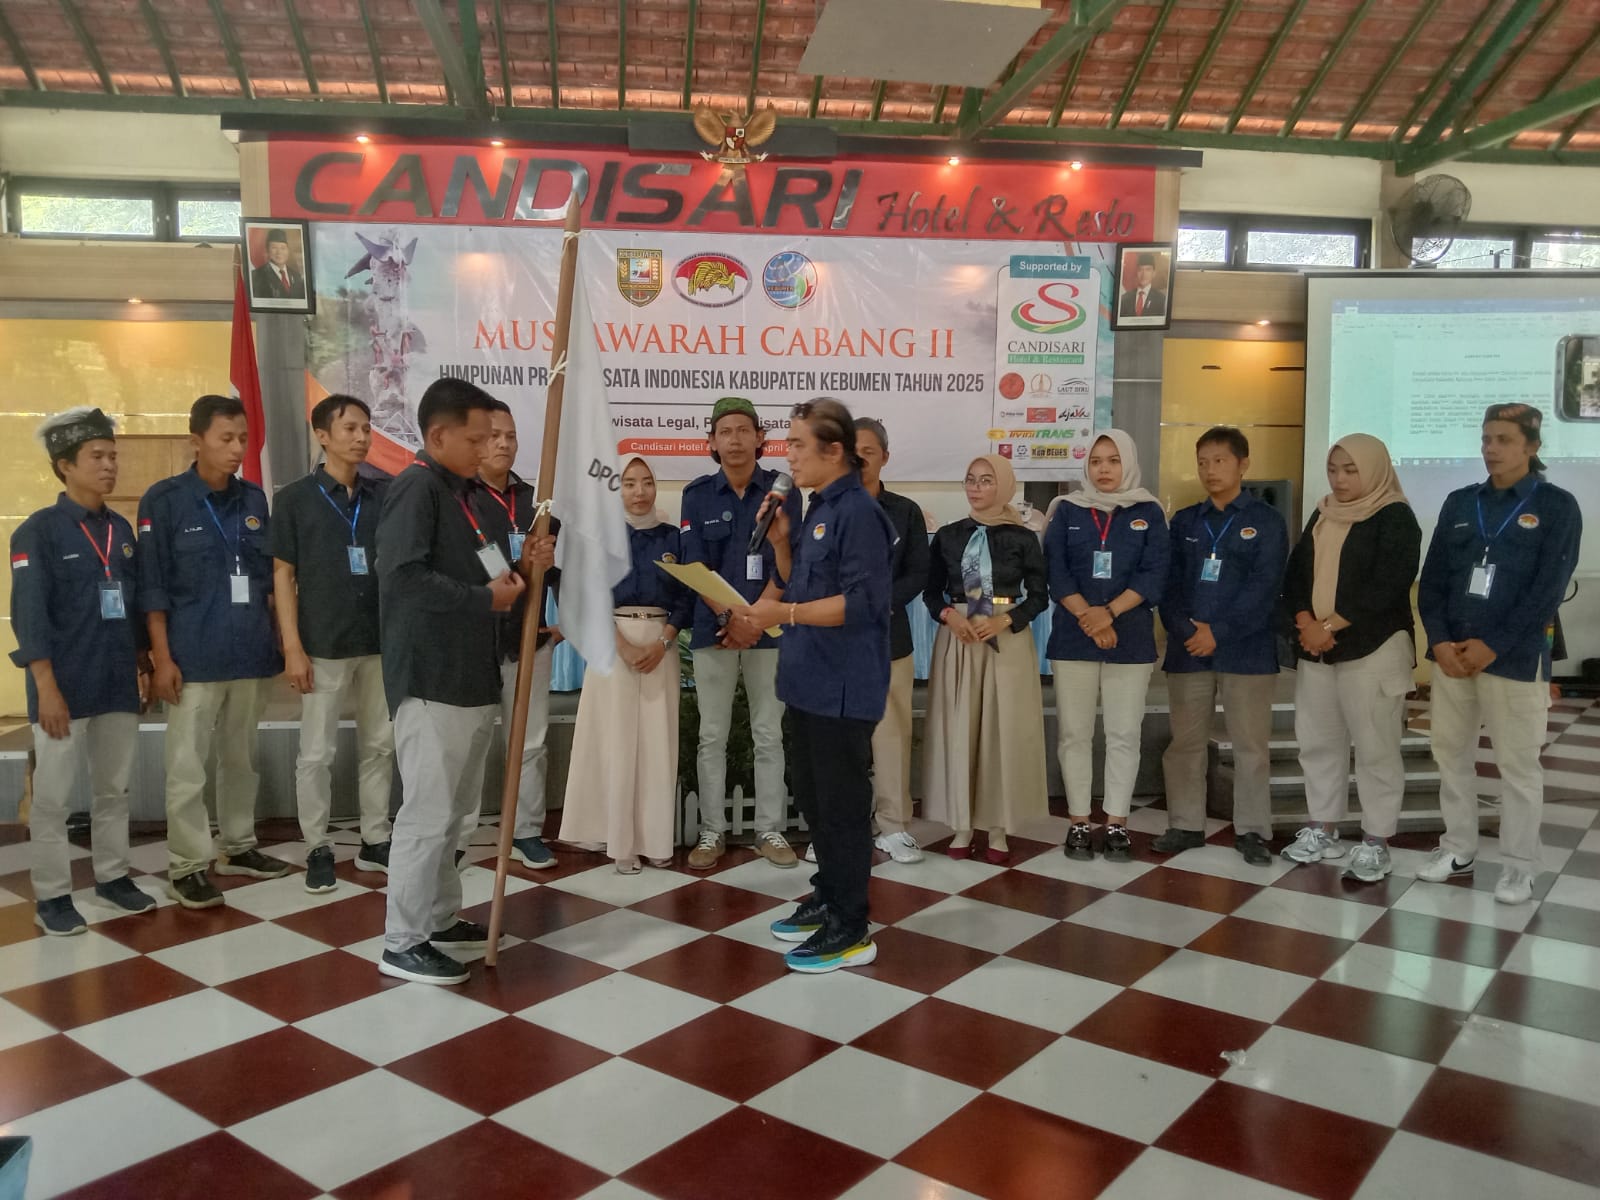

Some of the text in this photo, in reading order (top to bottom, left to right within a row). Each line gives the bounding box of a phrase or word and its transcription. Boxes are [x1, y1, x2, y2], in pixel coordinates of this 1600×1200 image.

[294, 151, 864, 230] CANDISARI
[877, 185, 1136, 239] Hotel & Resto
[1020, 261, 1082, 273] Supported by
[760, 325, 916, 358] CABANG
[929, 328, 955, 358] II
[1007, 340, 1085, 353] CANDISARI
[439, 364, 524, 387] HIMPUNAN
[644, 369, 725, 390] INDONESIA
[729, 371, 816, 391] KABUPATEN
[820, 373, 891, 392] KEBUMEN
[895, 373, 943, 392] TAHUN
[946, 374, 985, 393] 2025
[657, 416, 699, 431] Legal,
[630, 442, 676, 451] Candisari
[678, 442, 704, 452] Hotel
[587, 457, 621, 492] DPC
